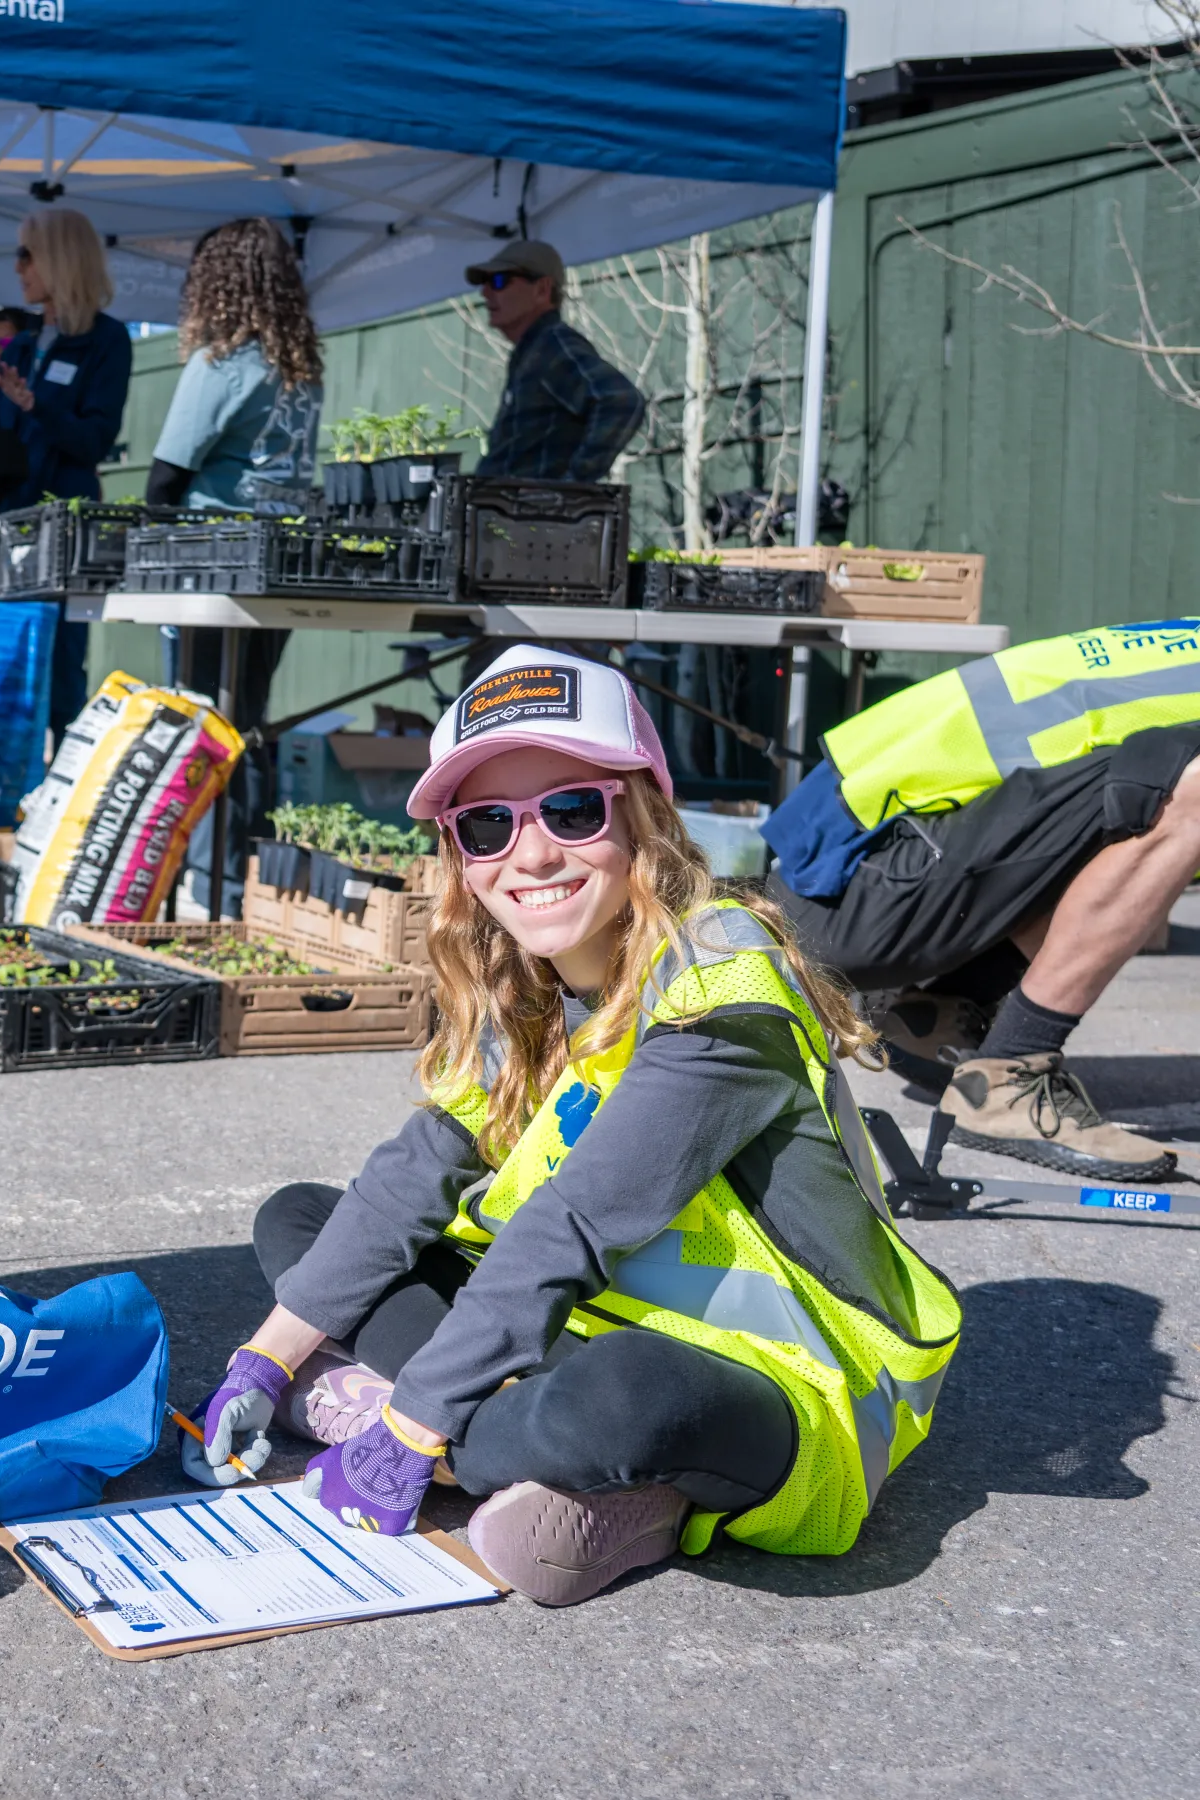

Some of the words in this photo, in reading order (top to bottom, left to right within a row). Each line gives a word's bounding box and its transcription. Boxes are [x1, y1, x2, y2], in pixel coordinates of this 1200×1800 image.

[468, 683, 560, 718] Roadhouse
[473, 669, 552, 696] CHERRYVILLE
[460, 722, 480, 740] GREAT
[480, 715, 499, 729] FOOD
[524, 706, 546, 715] COLD
[547, 705, 569, 714] BEER
[84, 768, 146, 865] POTTING
[143, 796, 187, 865] RAISED
[65, 861, 99, 908] MIX
[122, 868, 156, 911] BED
[1113, 1192, 1157, 1209] KEEP
